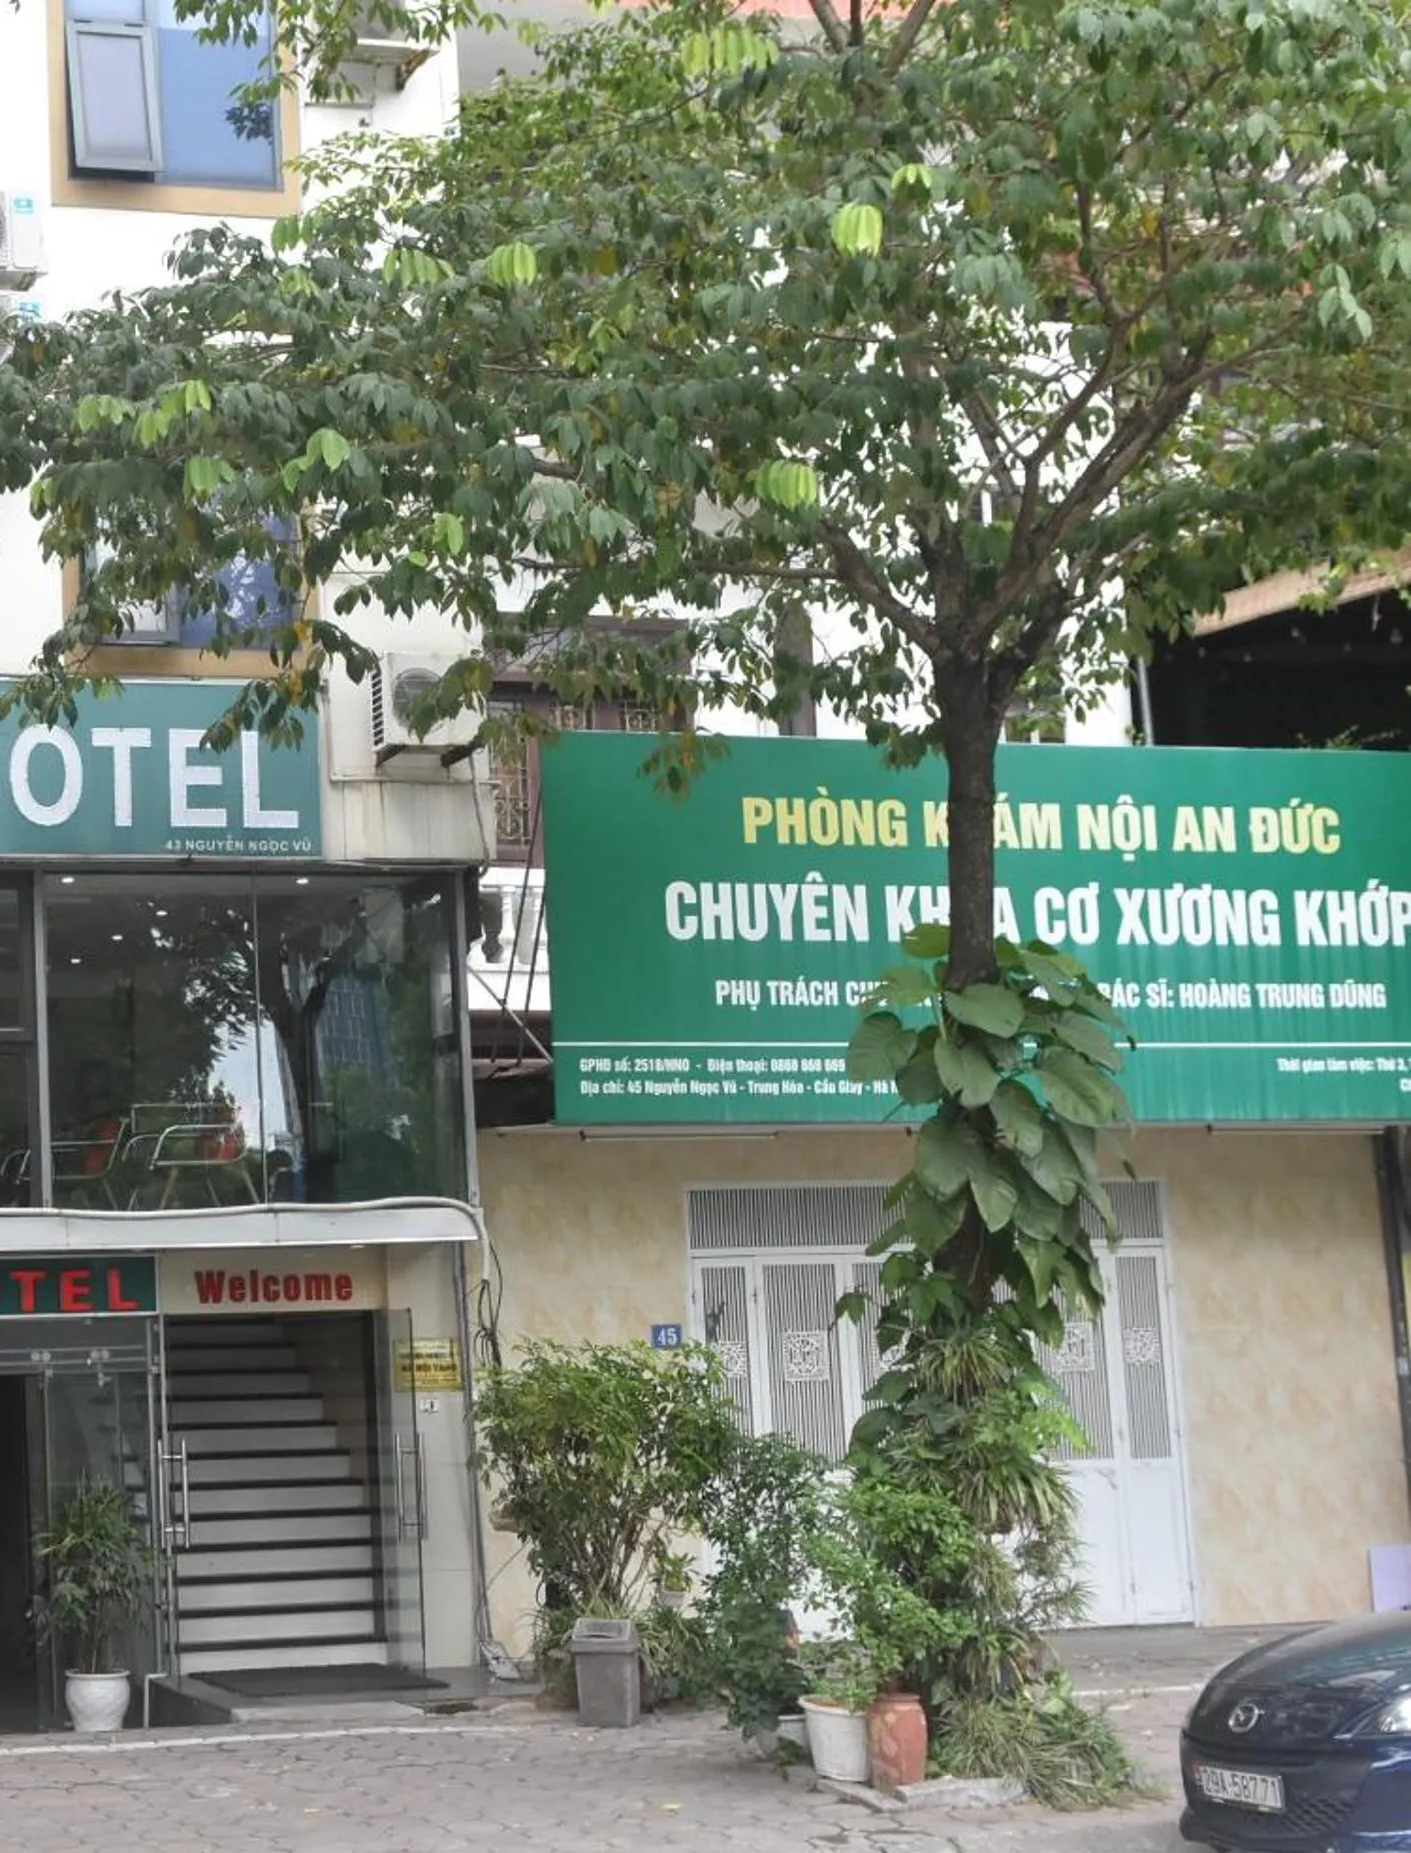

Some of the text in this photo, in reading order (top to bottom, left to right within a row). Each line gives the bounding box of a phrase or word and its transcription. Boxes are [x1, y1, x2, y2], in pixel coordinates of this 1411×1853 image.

[742, 785, 1341, 862] PHÒNG KÁM NỘI AN ĐỨC
[665, 870, 1411, 947] CHUYÊN KHA CƠ XƯƠNG KHỚP
[716, 979, 760, 1011] PHỤ
[767, 975, 838, 1007] TRÁCH
[1180, 978, 1251, 1009] HOÀNG
[1256, 983, 1324, 1009] TRUNG
[1329, 980, 1387, 1009] DŨNG
[747, 1080, 779, 1095] Trung
[195, 1270, 353, 1304] Welcome
[657, 1327, 677, 1346] 45
